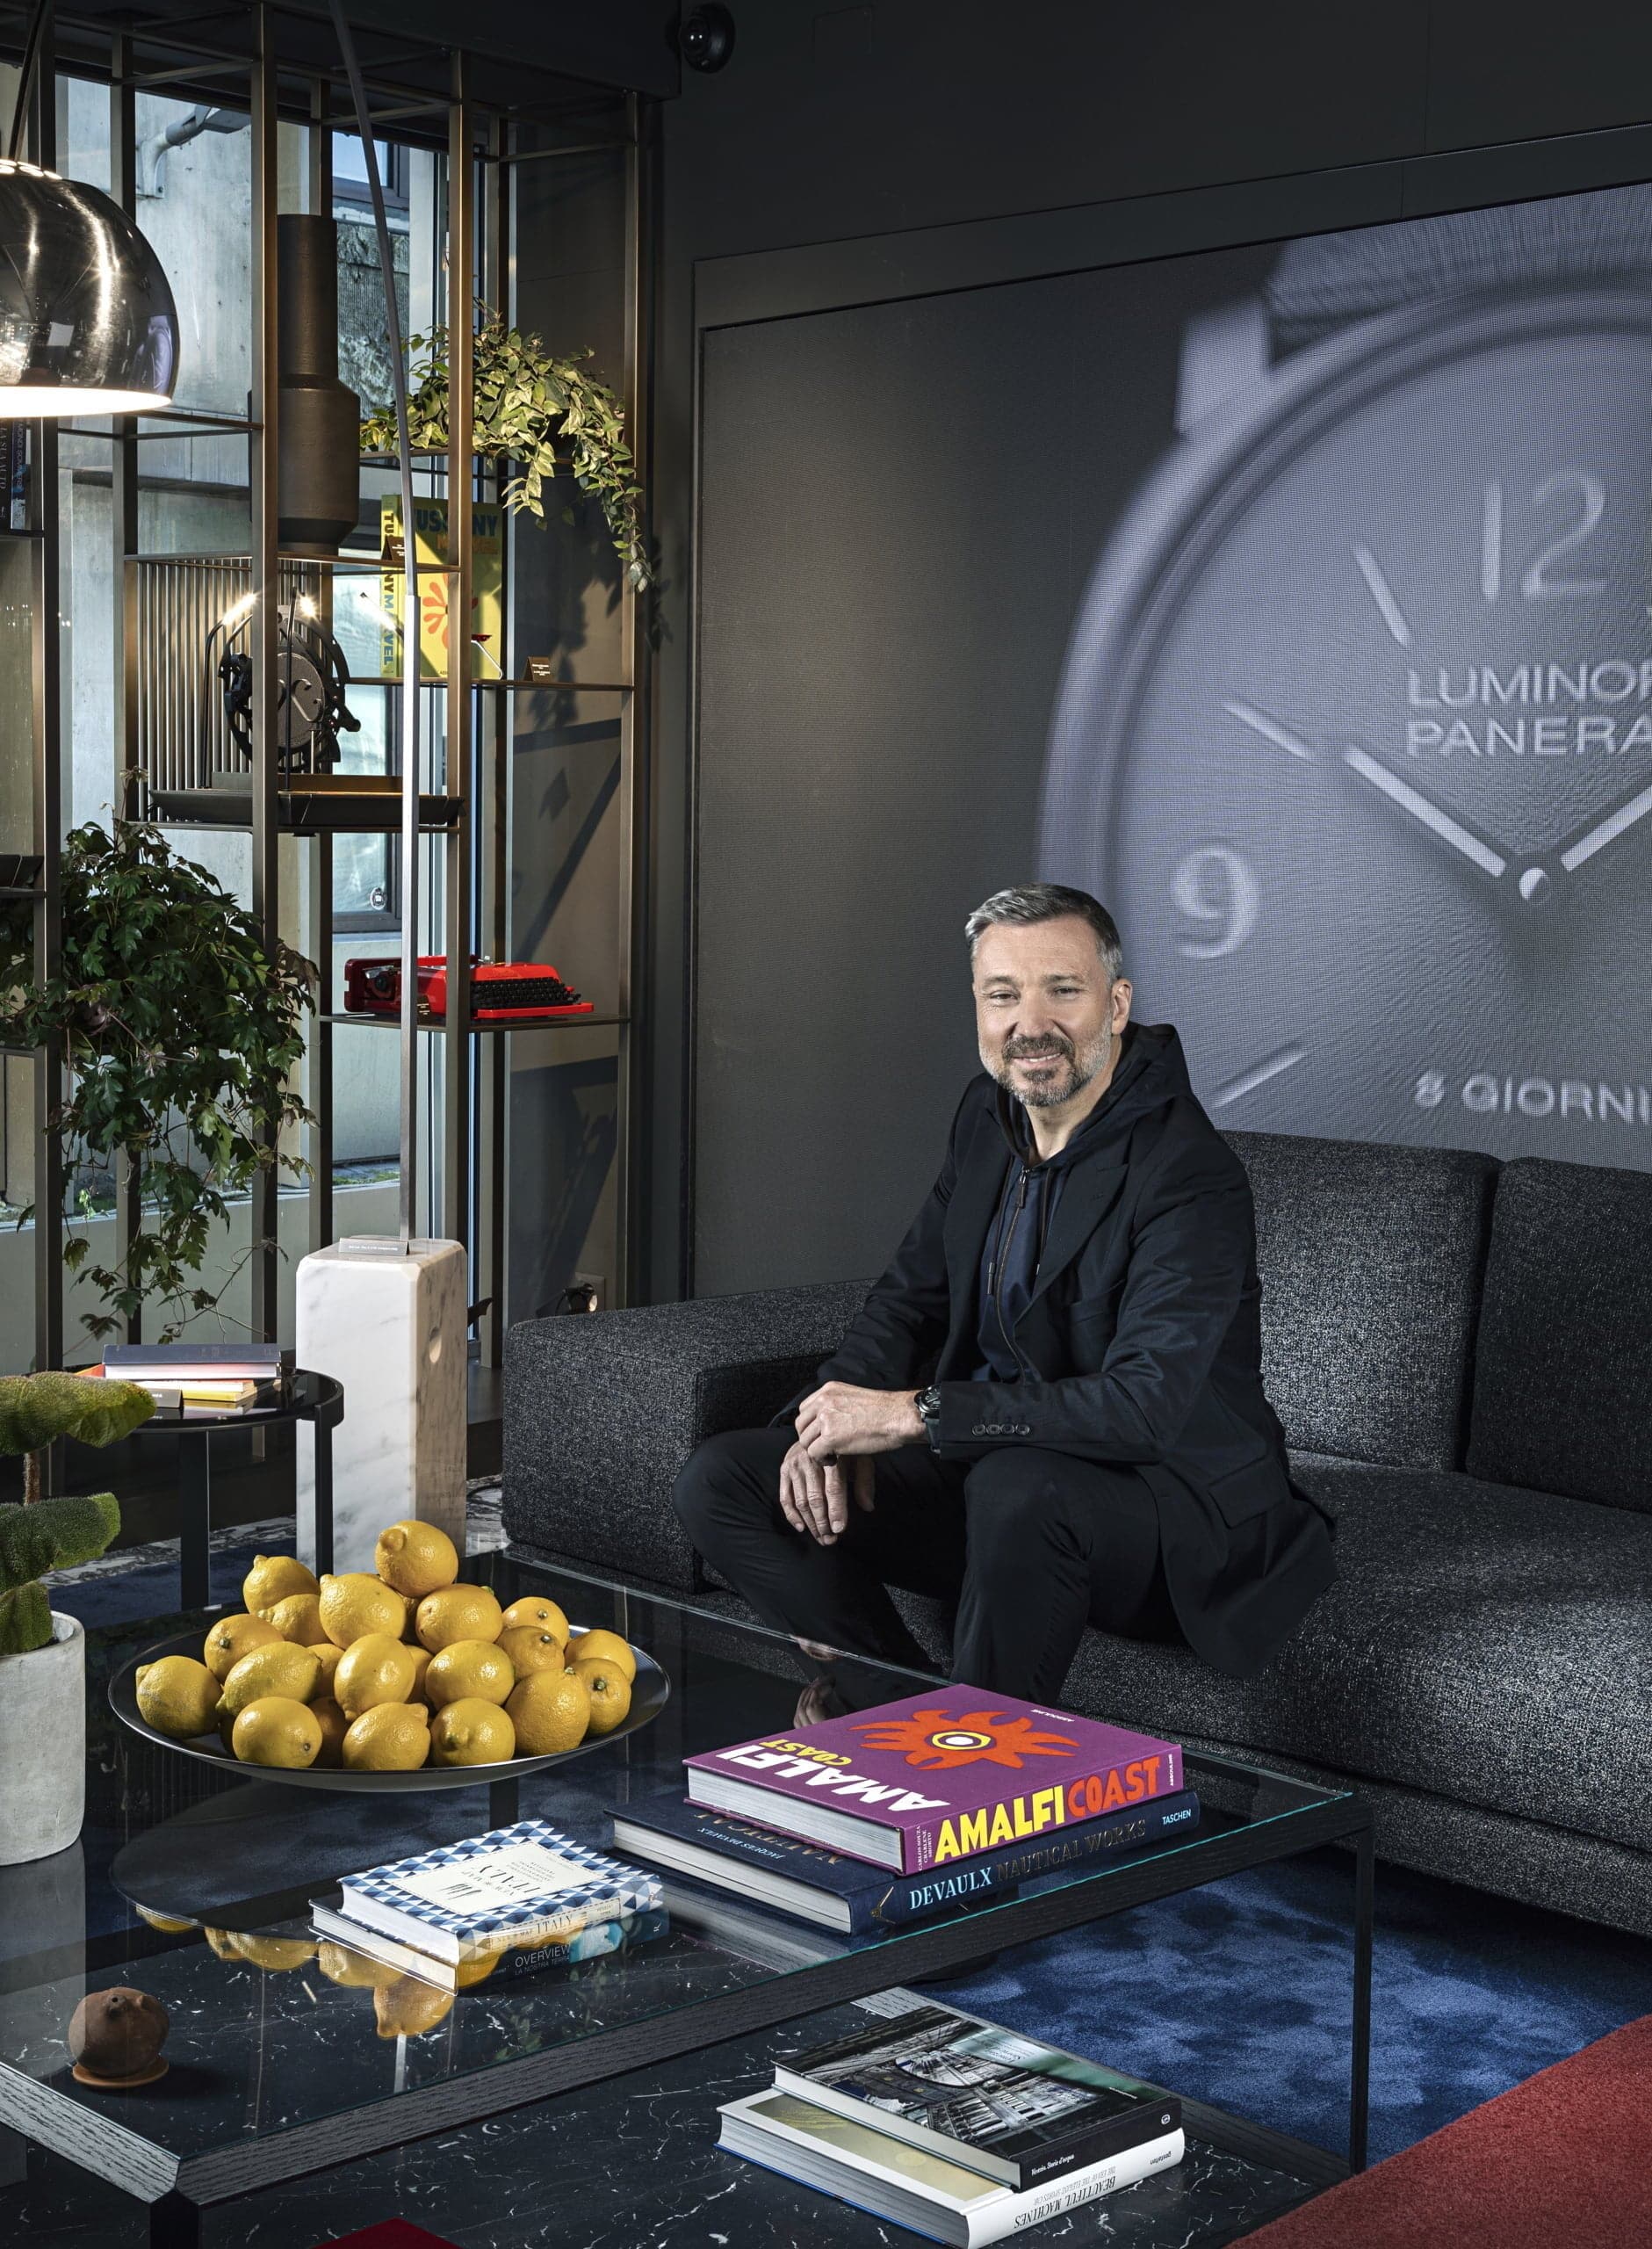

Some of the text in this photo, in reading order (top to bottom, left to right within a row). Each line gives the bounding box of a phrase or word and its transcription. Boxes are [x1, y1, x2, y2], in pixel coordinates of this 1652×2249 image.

[1481, 470, 1605, 603] 12
[383, 594, 394, 666] MVEL
[1172, 847, 1259, 958] 9
[716, 1745, 951, 1811] AMALFI
[759, 1739, 852, 1767] COAST
[934, 1755, 1161, 1863] AMALFI COAST
[1161, 1808, 1193, 1826] TASCHEN
[697, 1826, 787, 1861] JACQUES DEVAULX
[909, 1819, 1147, 1911] DEVAULX NAUTICAL WORKS
[537, 1914, 574, 1934] ITALY
[515, 1942, 571, 1968] OVERVIEW
[1150, 2151, 1172, 2166] gestalten
[1014, 2175, 1116, 2230] BEAUTIFUL MACHINES
